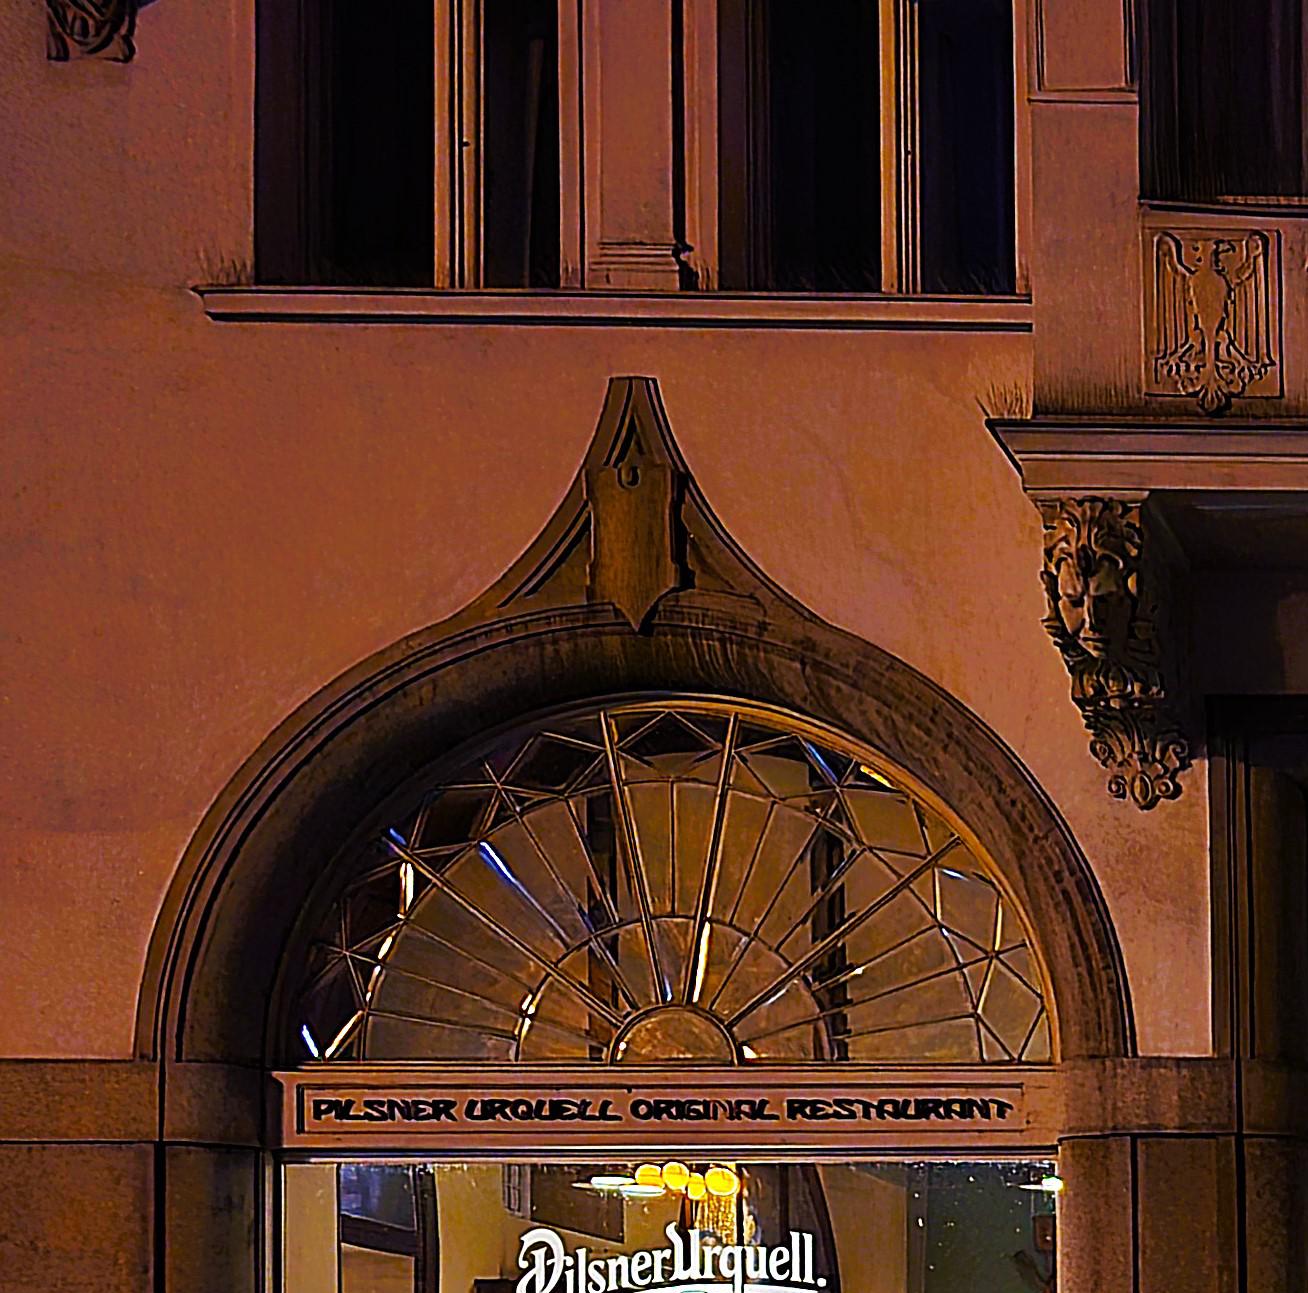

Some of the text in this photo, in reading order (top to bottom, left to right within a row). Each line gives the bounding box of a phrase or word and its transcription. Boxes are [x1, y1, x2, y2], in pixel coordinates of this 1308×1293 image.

[311, 1098, 1014, 1122] PILSNER URQUELL ORIGINAL RESTAURANT
